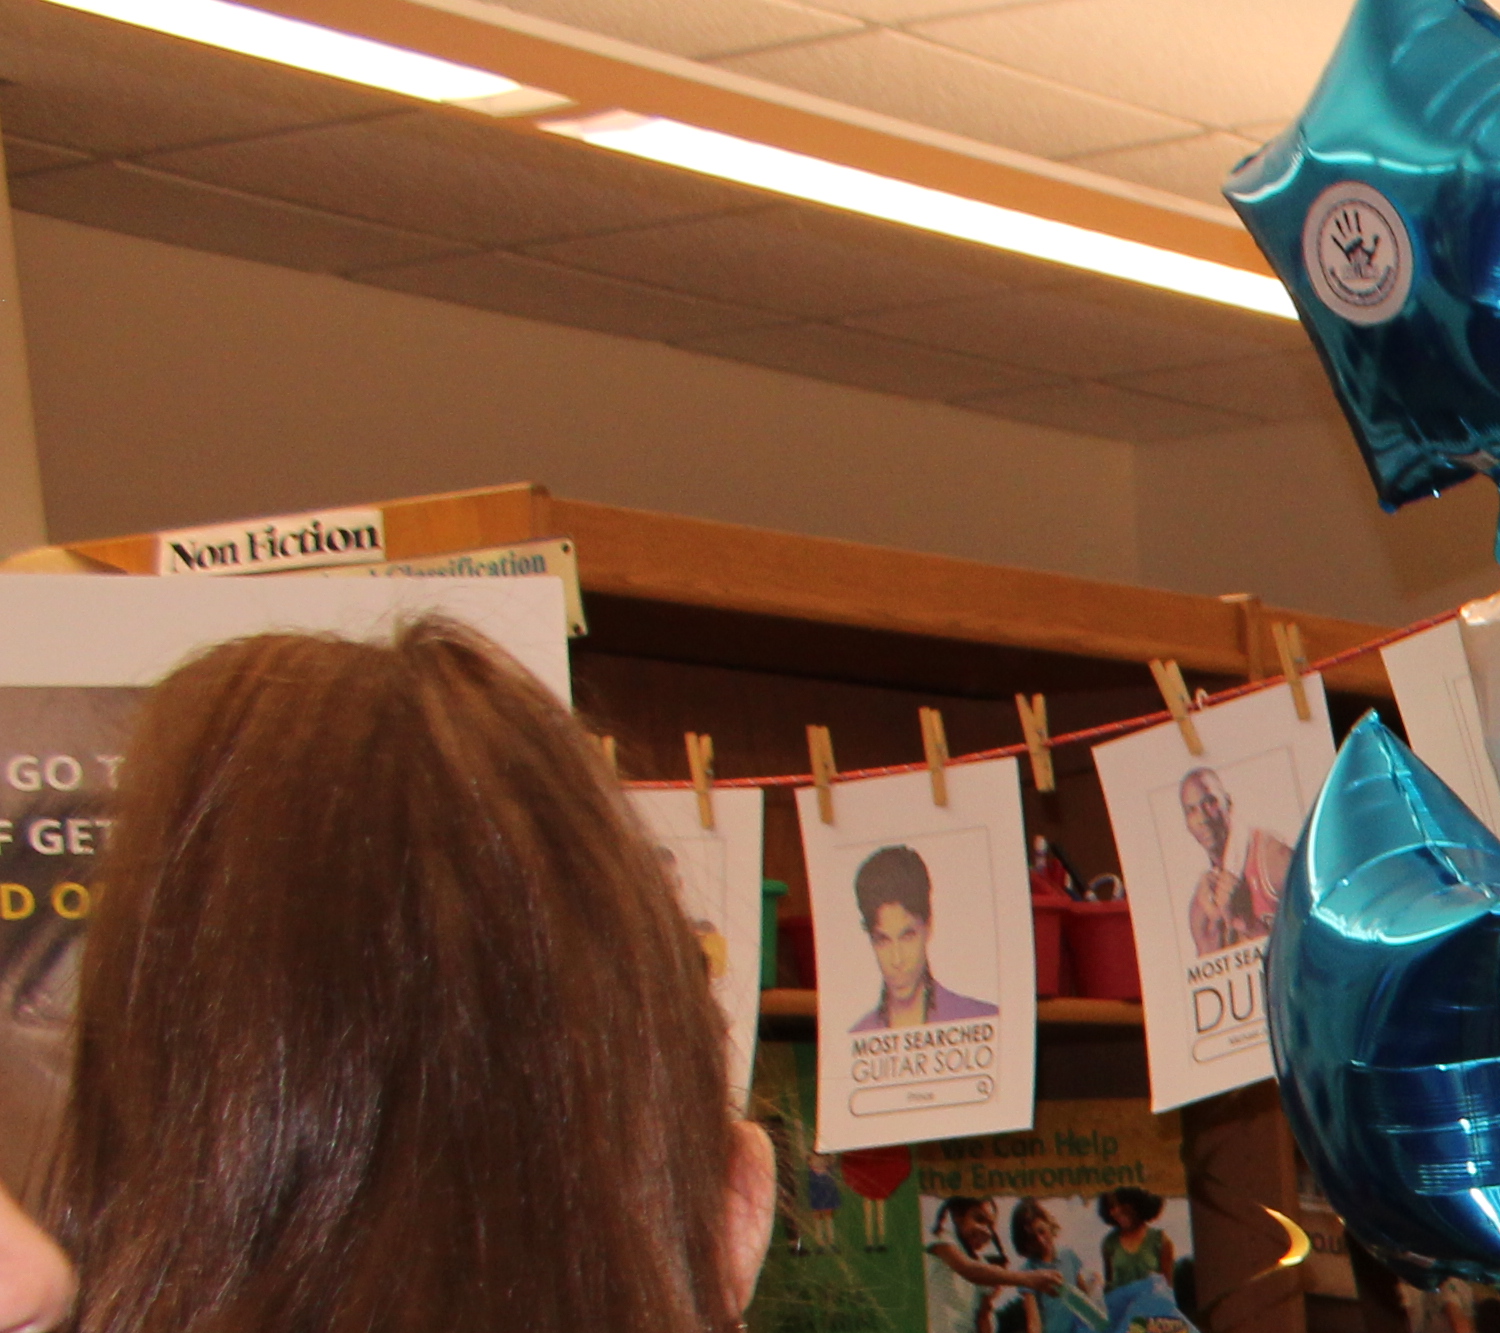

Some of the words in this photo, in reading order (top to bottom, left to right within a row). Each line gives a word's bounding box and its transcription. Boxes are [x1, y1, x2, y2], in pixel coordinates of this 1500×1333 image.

[170, 538, 241, 573] Non
[246, 519, 382, 561] Fiction
[851, 1034, 901, 1057] MOST
[903, 1023, 994, 1051] SEARCHED
[851, 1053, 928, 1084] GUITAR
[933, 1044, 994, 1074] SOLO
[1053, 1128, 1119, 1161] Help
[919, 1165, 962, 1192] the
[972, 1159, 1147, 1192] Environment
